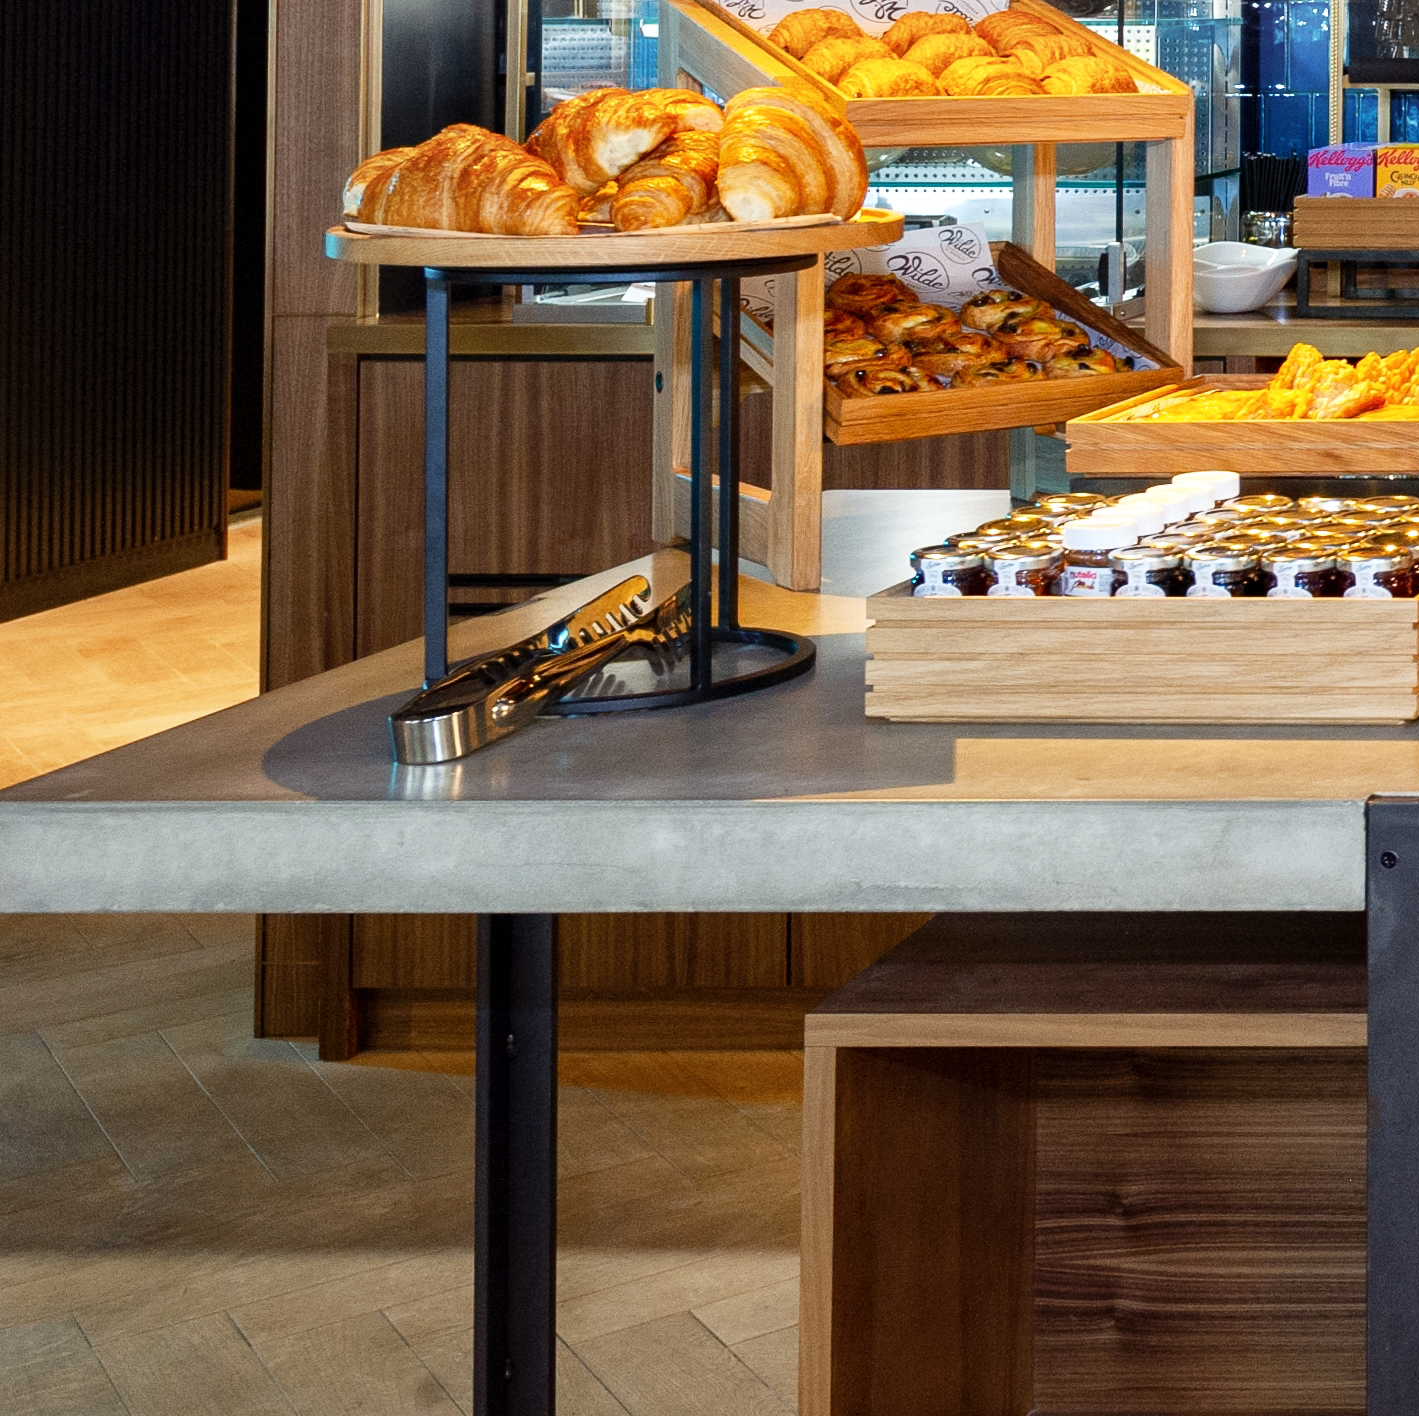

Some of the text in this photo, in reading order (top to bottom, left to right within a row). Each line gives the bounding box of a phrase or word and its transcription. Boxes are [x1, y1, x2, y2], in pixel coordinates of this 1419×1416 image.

[1308, 150, 1373, 172] Kellogg's
[938, 229, 979, 258] Wilde
[887, 254, 945, 290] Wilde
